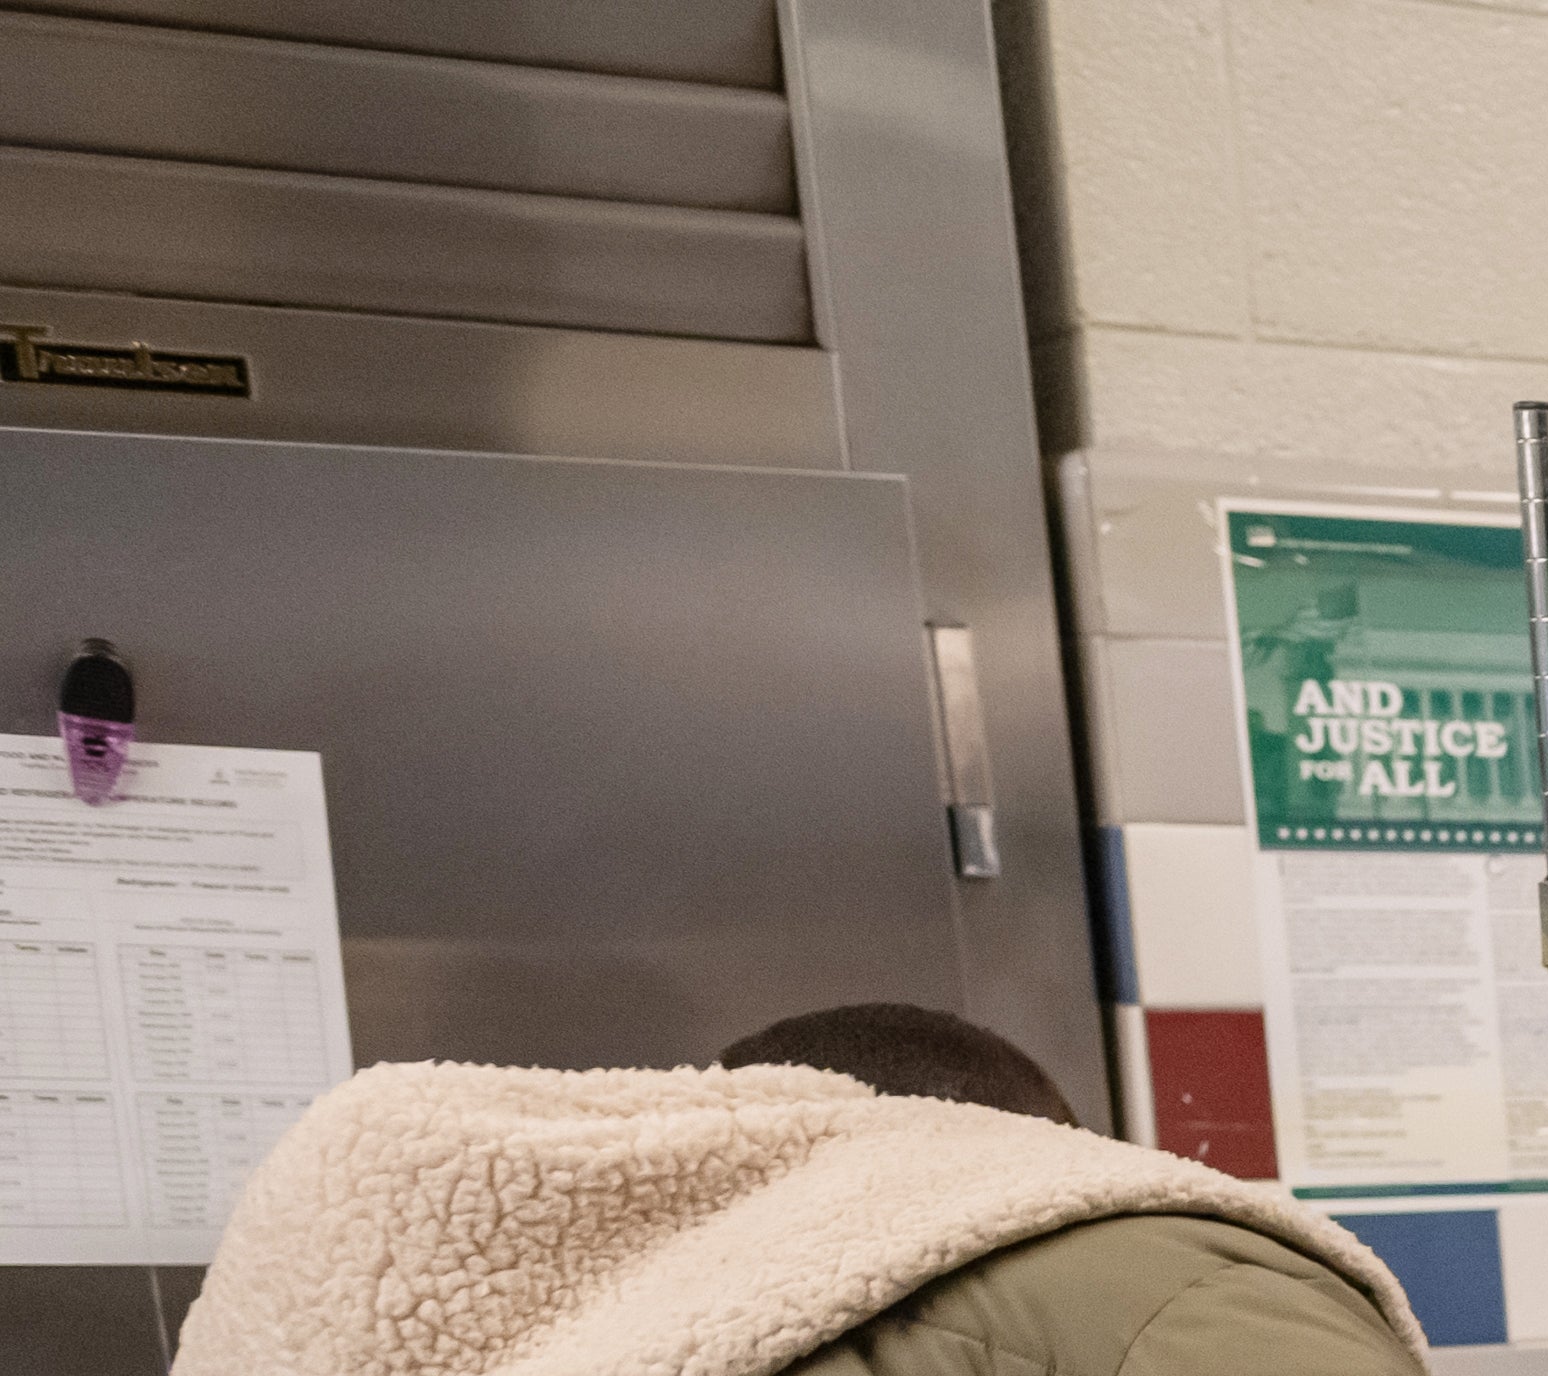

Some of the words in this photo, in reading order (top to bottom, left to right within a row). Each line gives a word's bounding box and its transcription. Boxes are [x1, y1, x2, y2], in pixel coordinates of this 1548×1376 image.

[1295, 678, 1403, 718] AND
[1295, 717, 1508, 758] JUSTICE
[1300, 760, 1352, 783] FOR
[1359, 758, 1456, 798] ALL
